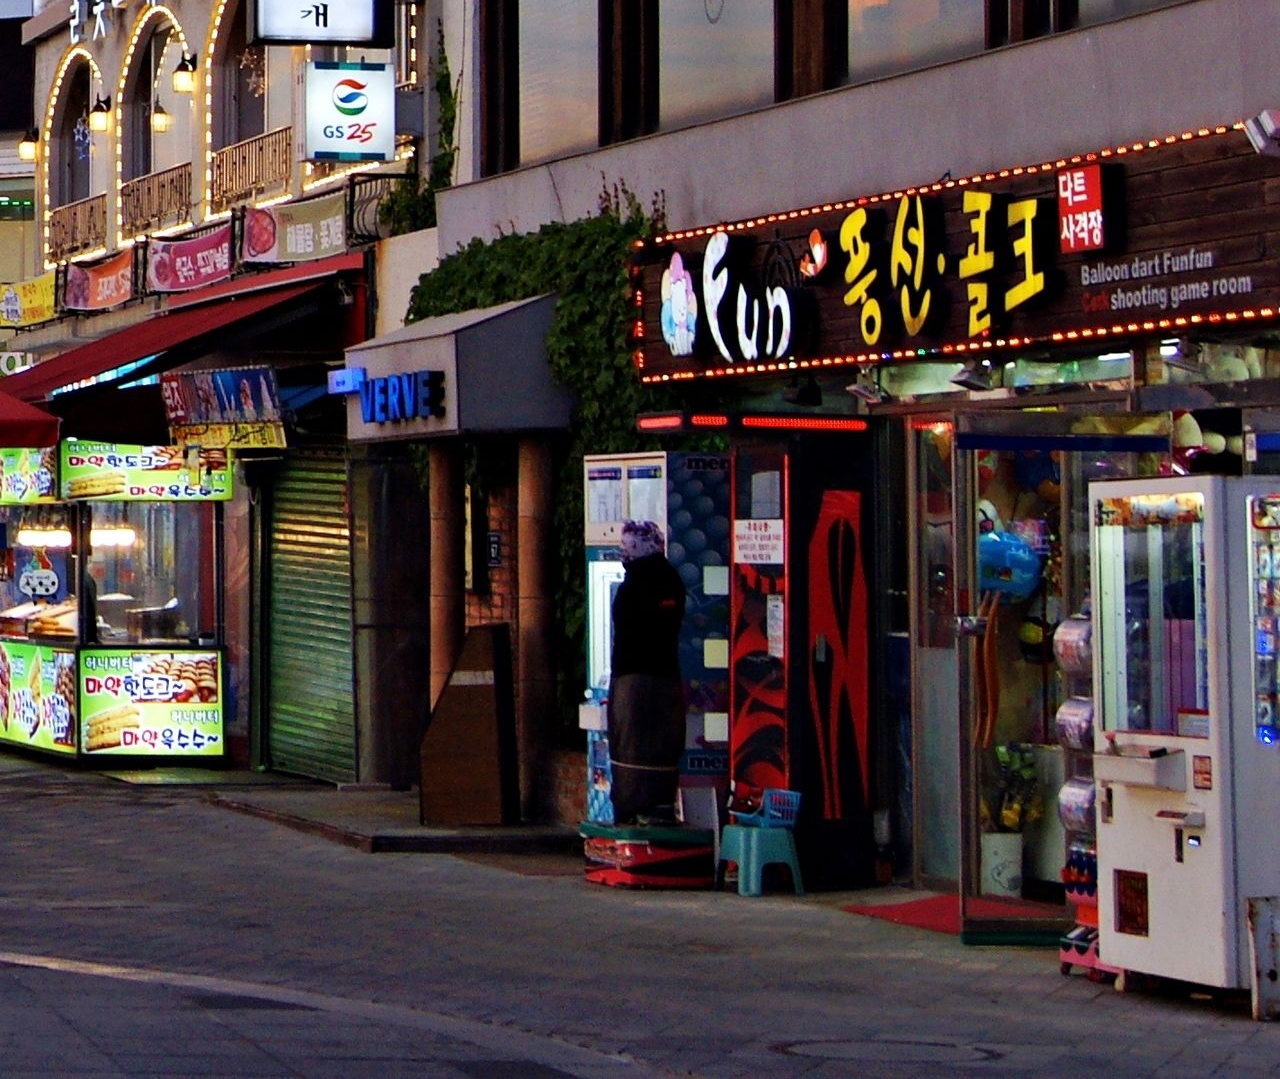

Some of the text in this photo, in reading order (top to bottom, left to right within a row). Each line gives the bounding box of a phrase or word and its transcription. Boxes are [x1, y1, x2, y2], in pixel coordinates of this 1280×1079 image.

[1058, 171, 1088, 206] 다트
[1060, 209, 1103, 248] 사격장
[1081, 248, 1213, 286] Balloon dart Funfun
[1110, 284, 1168, 311] shooting
[1171, 281, 1209, 308] game
[1212, 275, 1252, 296] room
[359, 370, 438, 424] VERVE
